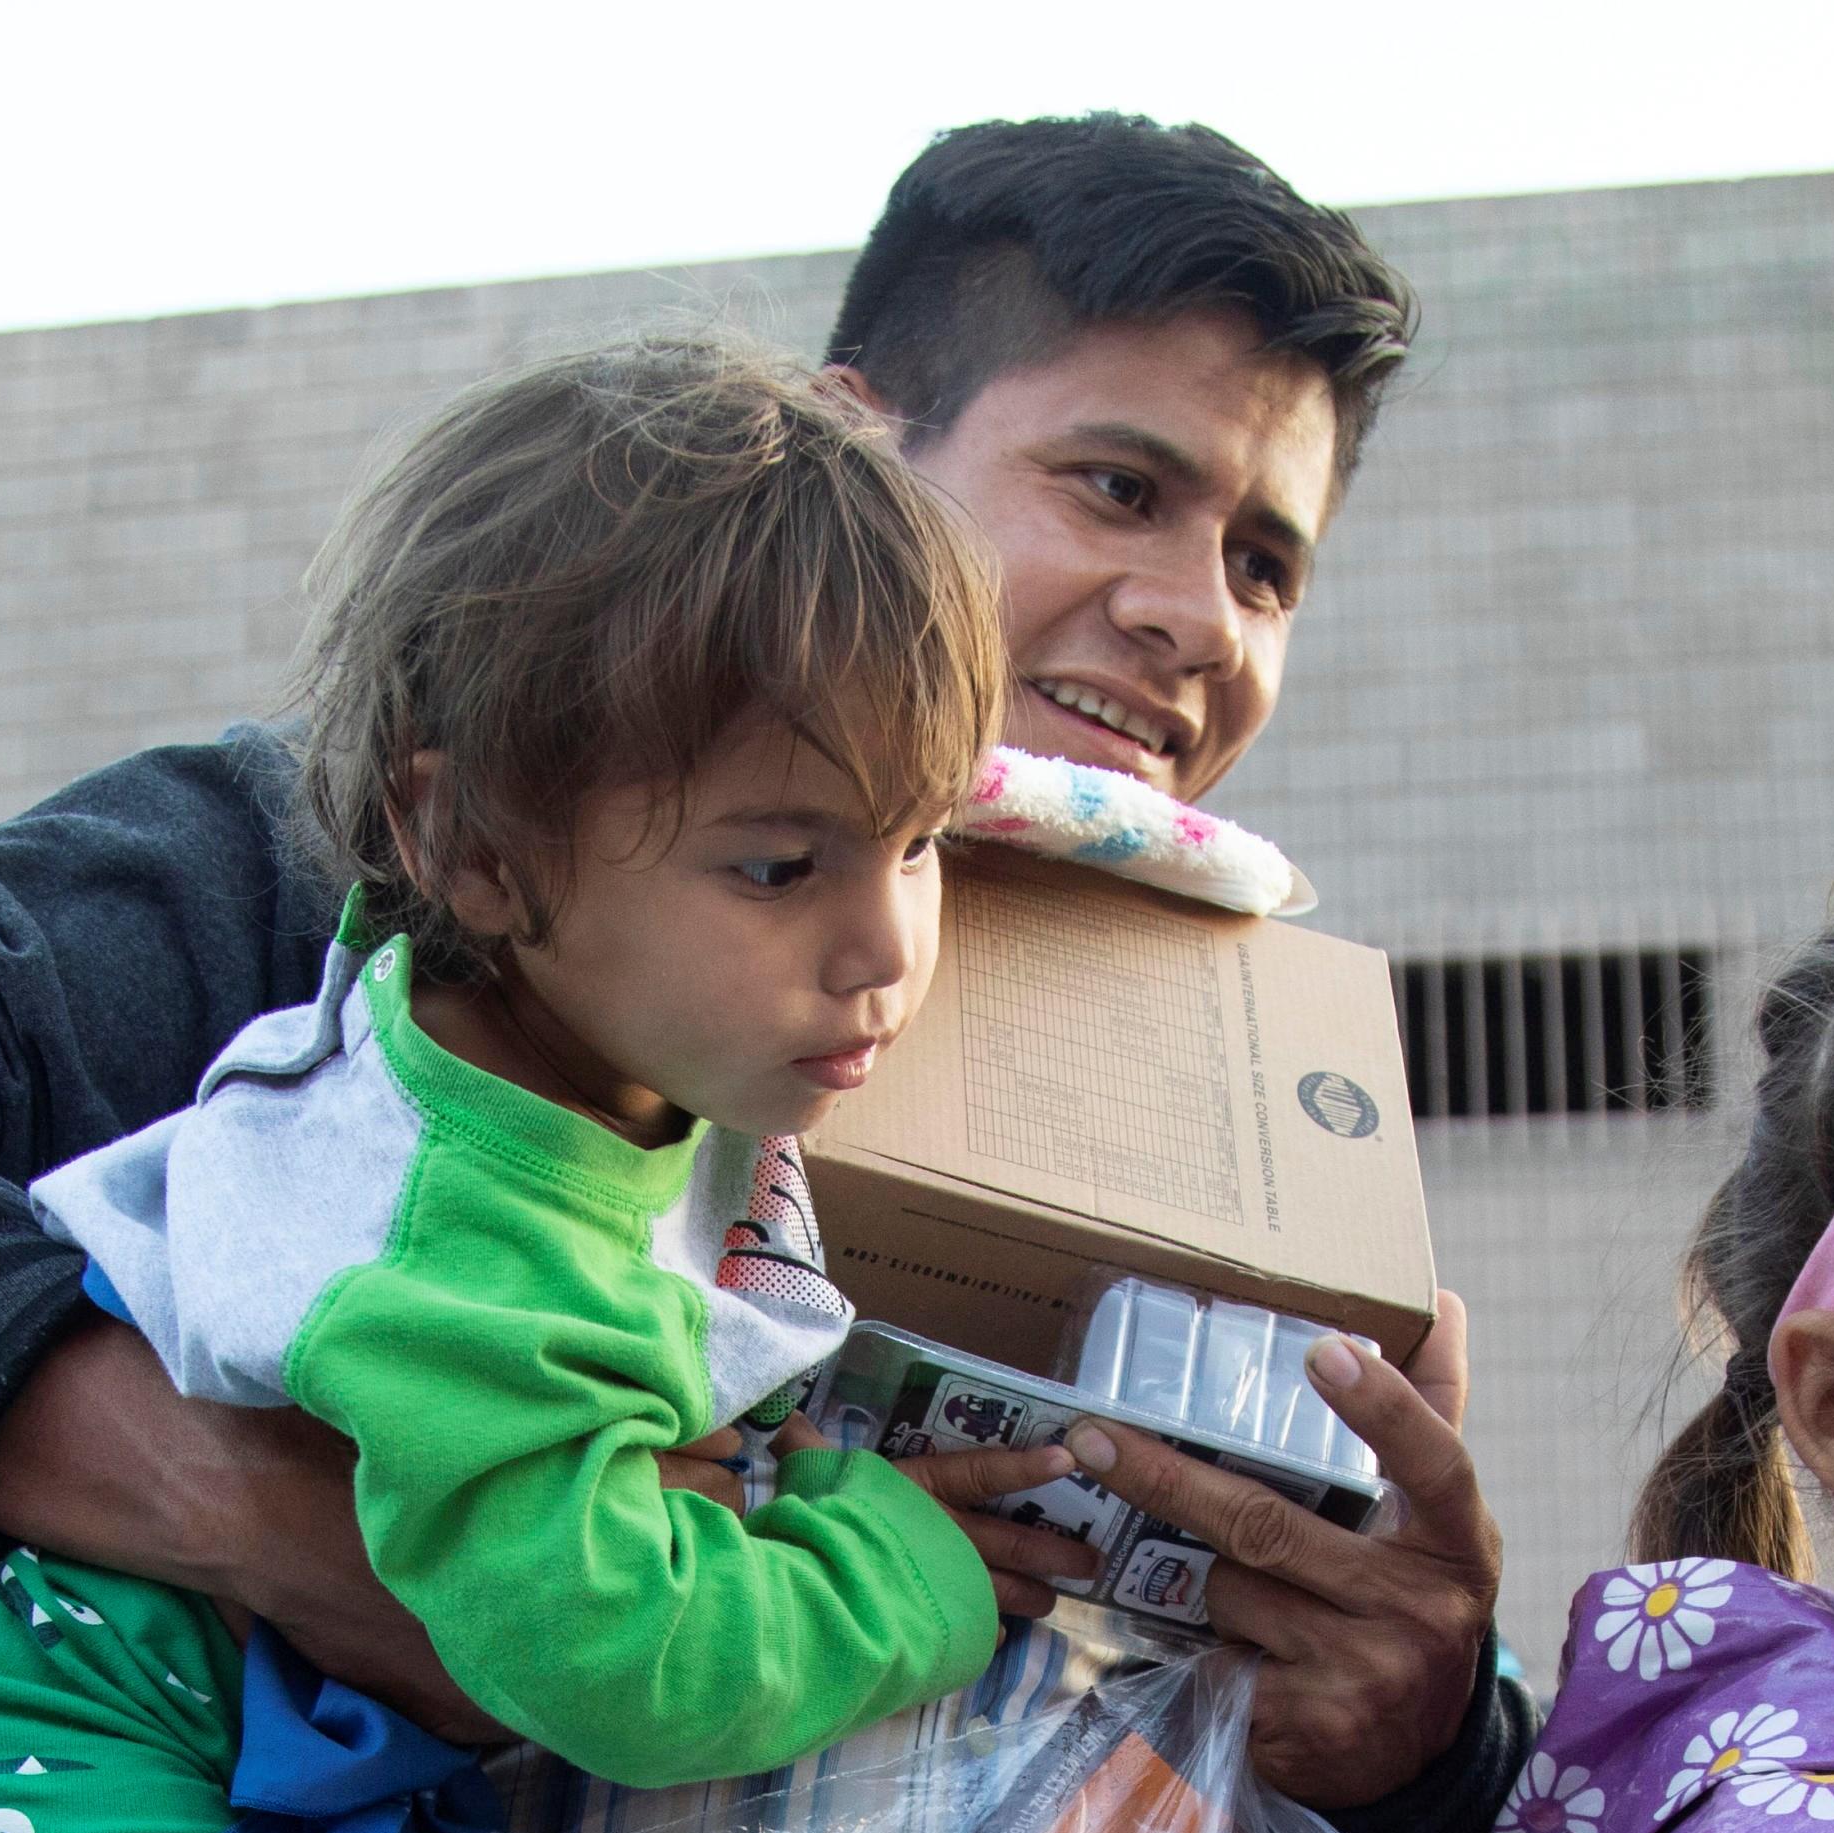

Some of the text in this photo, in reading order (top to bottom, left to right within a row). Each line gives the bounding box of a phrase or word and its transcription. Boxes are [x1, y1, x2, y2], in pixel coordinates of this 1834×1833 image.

[1237, 944, 1281, 1233] USA/INTERNATIONAL SIZE CONVERSION TABLE
